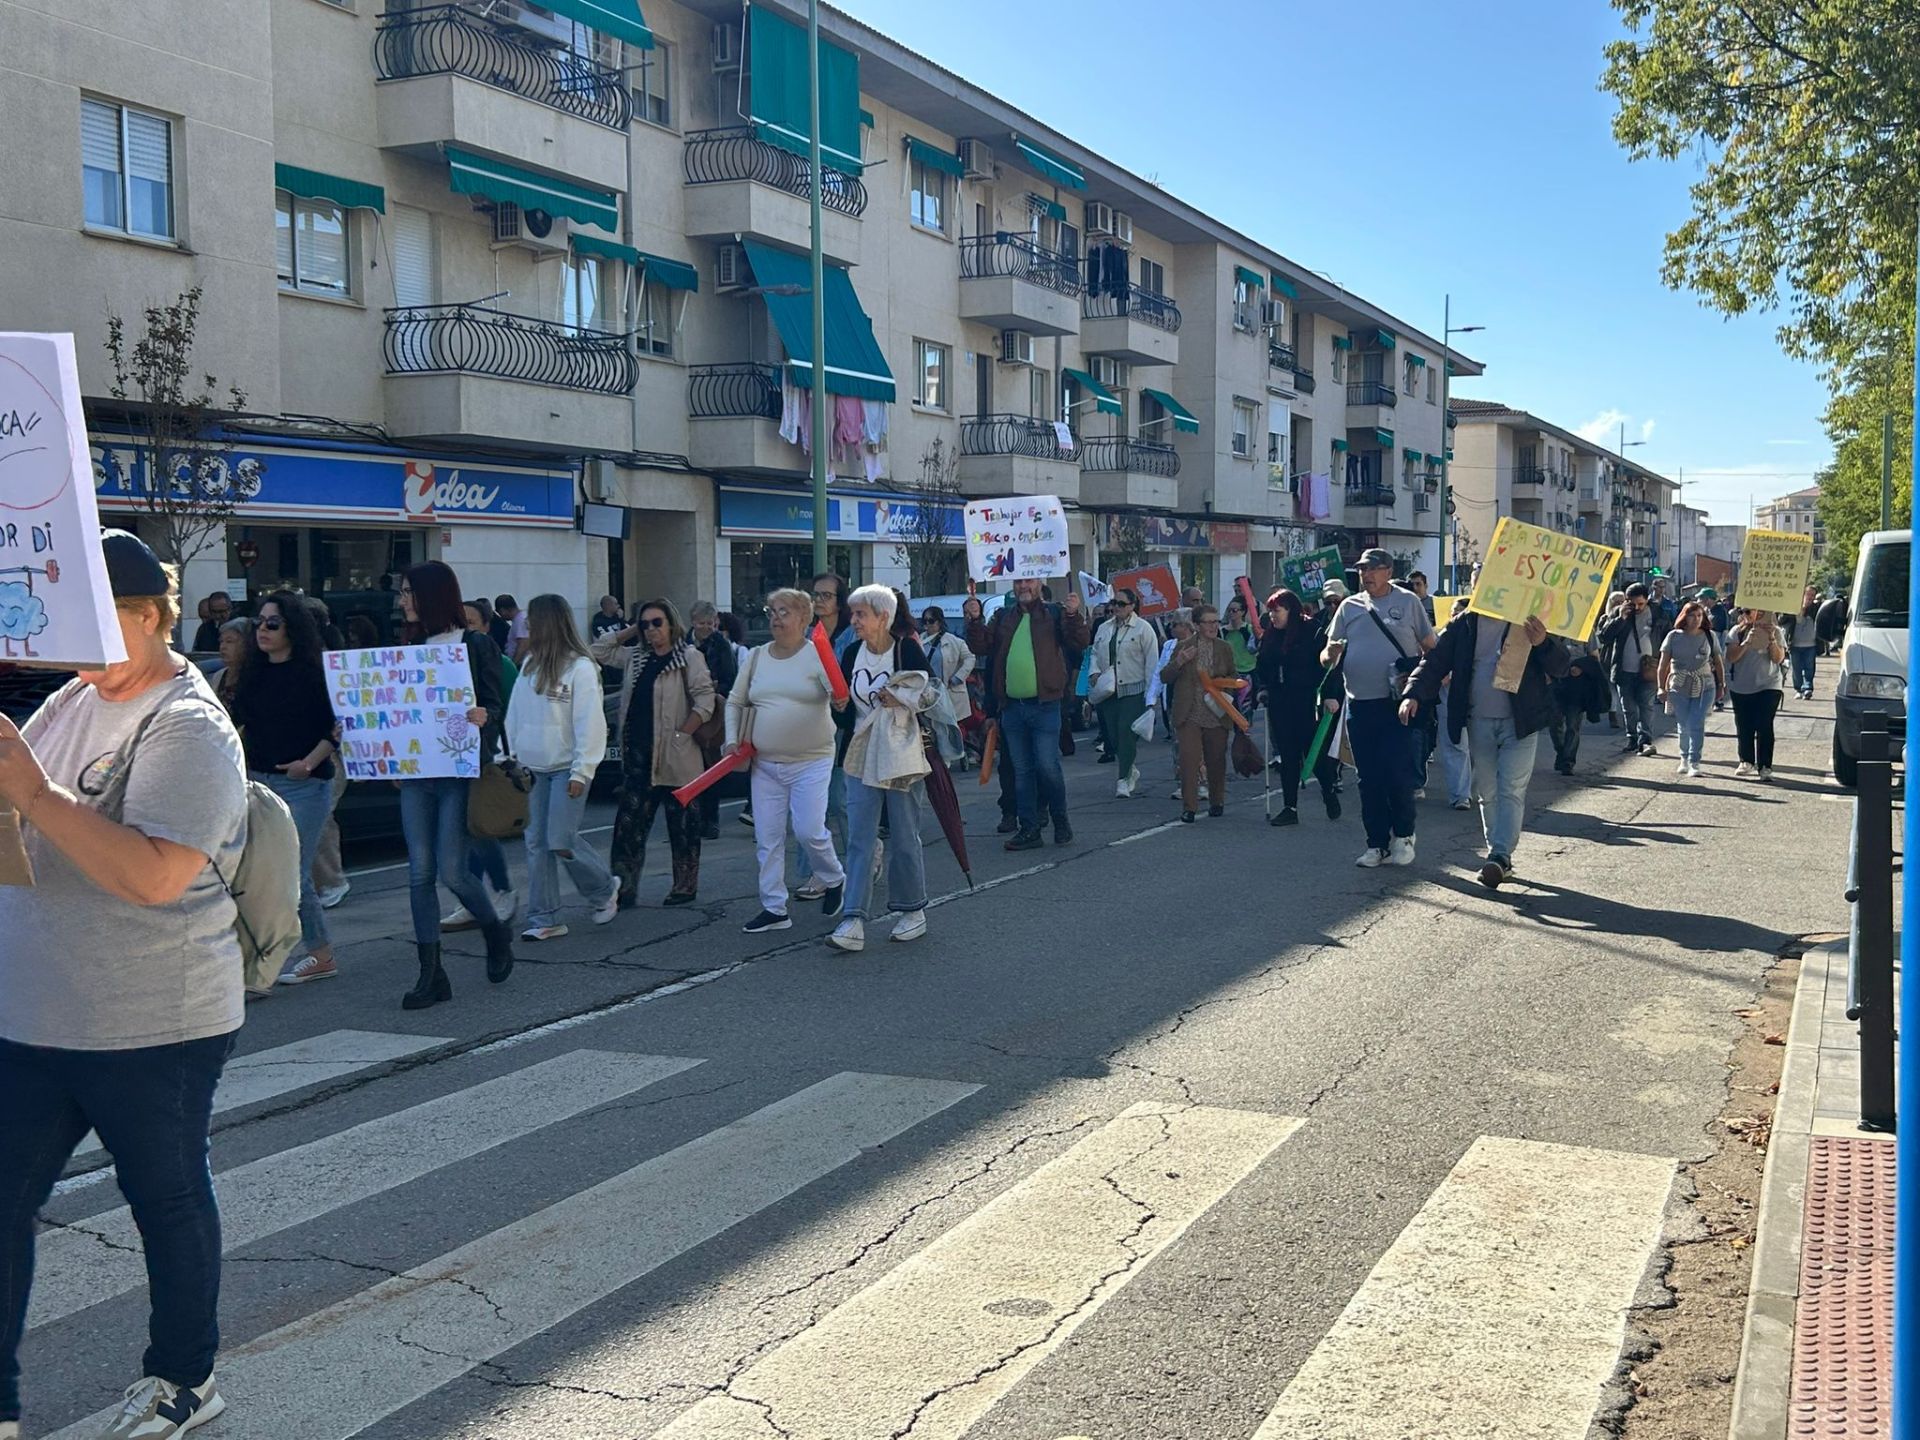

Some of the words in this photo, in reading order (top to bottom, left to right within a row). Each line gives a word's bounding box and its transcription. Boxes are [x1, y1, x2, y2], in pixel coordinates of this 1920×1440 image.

[1514, 554, 1538, 579] ES
[1483, 585, 1510, 609] DE
[359, 650, 405, 669] ALMA
[416, 648, 444, 665] QUE
[447, 645, 465, 664] SE
[338, 670, 384, 688] CURA
[388, 668, 437, 685] PUEDE
[336, 687, 397, 708] CURAR
[404, 687, 418, 704] A
[425, 686, 475, 706] OTROS
[342, 740, 396, 760] AYUDA
[407, 738, 423, 755] A
[345, 758, 422, 777] MEJORAR
